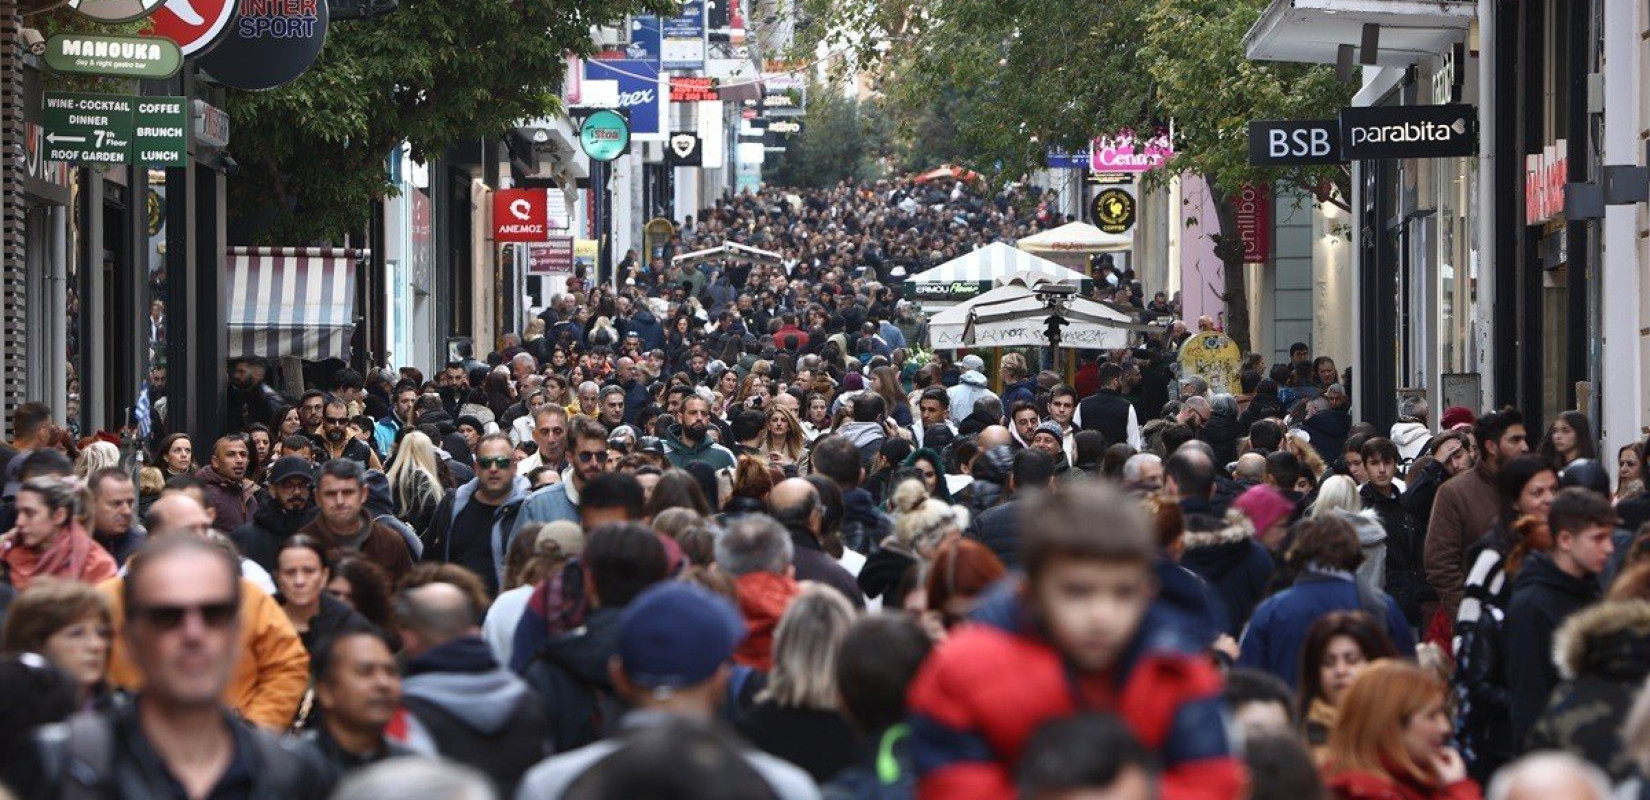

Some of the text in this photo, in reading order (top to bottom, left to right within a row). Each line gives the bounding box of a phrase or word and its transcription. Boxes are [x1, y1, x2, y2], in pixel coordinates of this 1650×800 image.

[239, 0, 317, 16] INTER
[239, 17, 318, 38] SPORT
[62, 39, 161, 60] MANOUKA
[75, 58, 88, 66] day
[96, 60, 112, 68] night
[113, 61, 134, 69] gastro
[138, 103, 181, 114] COFFEE
[69, 115, 108, 125] DINNER
[137, 127, 182, 137] BRUNCH
[1351, 121, 1451, 147] parabita
[93, 130, 106, 148] 7
[106, 139, 127, 147] Floor
[1269, 128, 1331, 158] BSB
[51, 150, 124, 162] ROOF GARDEN
[141, 151, 178, 160] LUNCH
[915, 285, 949, 293] ERMOU
